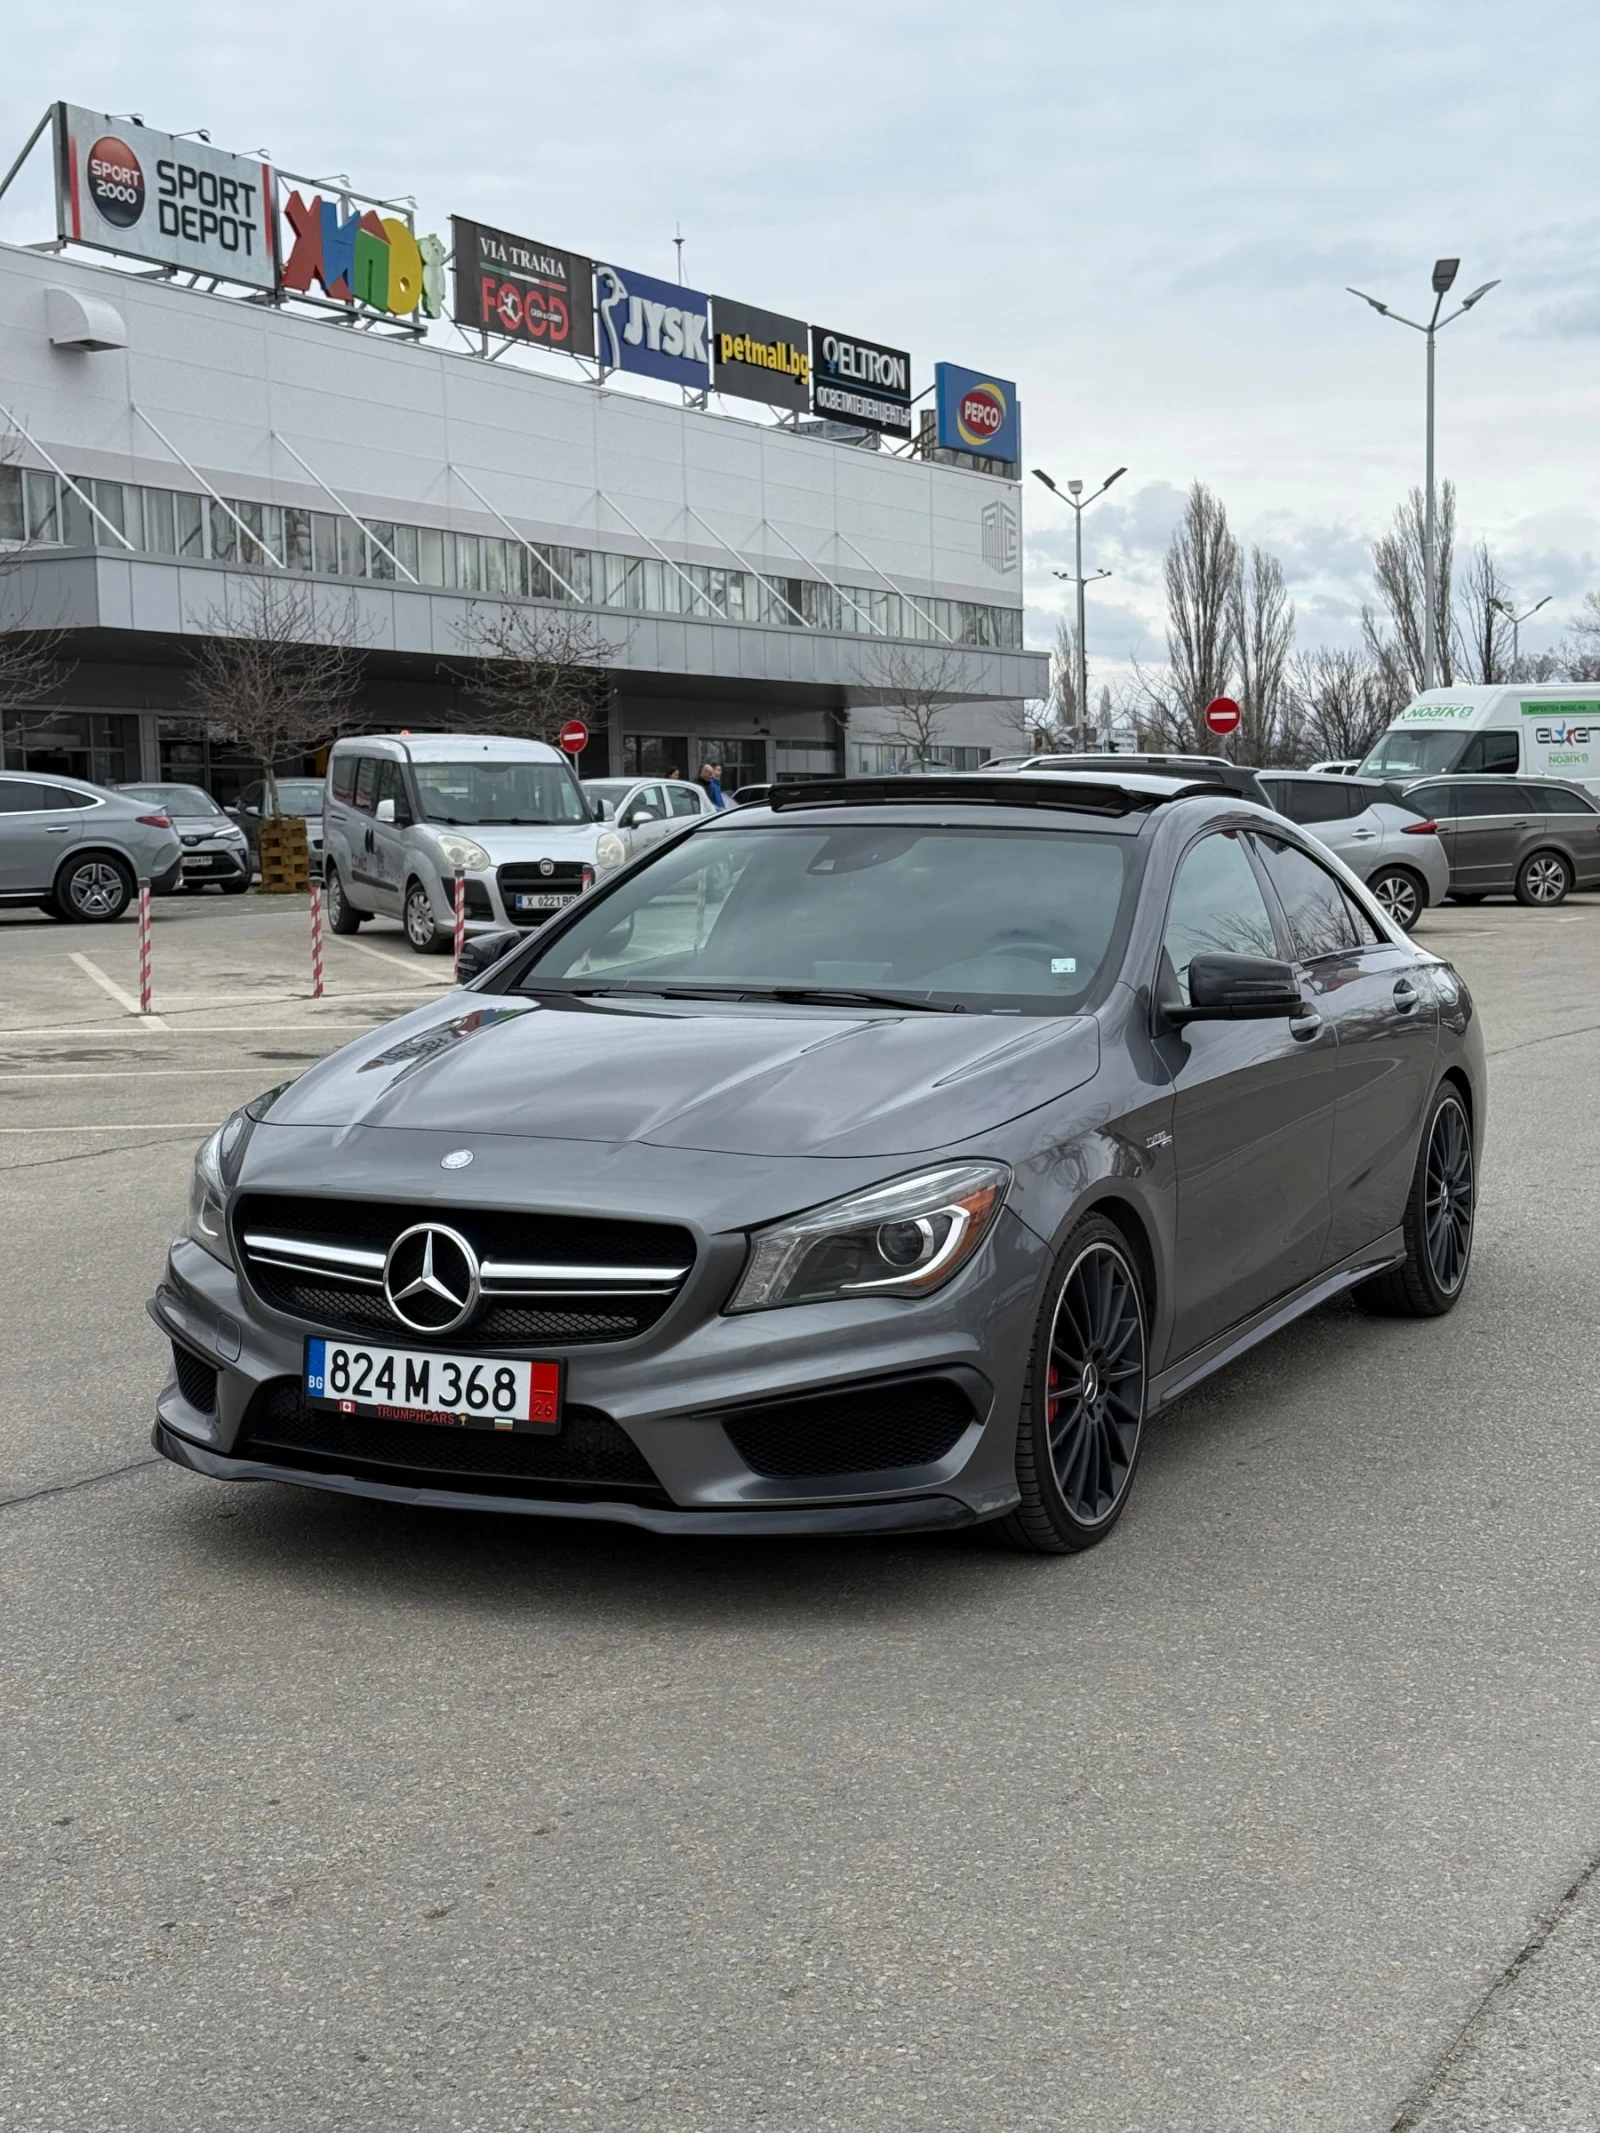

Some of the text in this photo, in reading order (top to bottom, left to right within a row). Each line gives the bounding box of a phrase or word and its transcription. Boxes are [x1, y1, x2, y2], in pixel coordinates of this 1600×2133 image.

[90, 158, 141, 187] SPORT
[96, 176, 137, 205] 2000
[156, 159, 257, 218] SPORT
[158, 198, 257, 256] DEPOT
[480, 237, 566, 279] VIA TRAKIA
[481, 276, 570, 341] FOOD
[623, 295, 708, 363] JYSK
[720, 333, 810, 385] petmall.bg
[964, 399, 999, 427] PEPCO
[527, 896, 534, 907] X
[538, 896, 560, 907] 0221
[308, 1349, 517, 1412] BG 824 M 368
[376, 1404, 455, 1425] TRIUMPHCARS
[534, 1400, 553, 1417] 26
